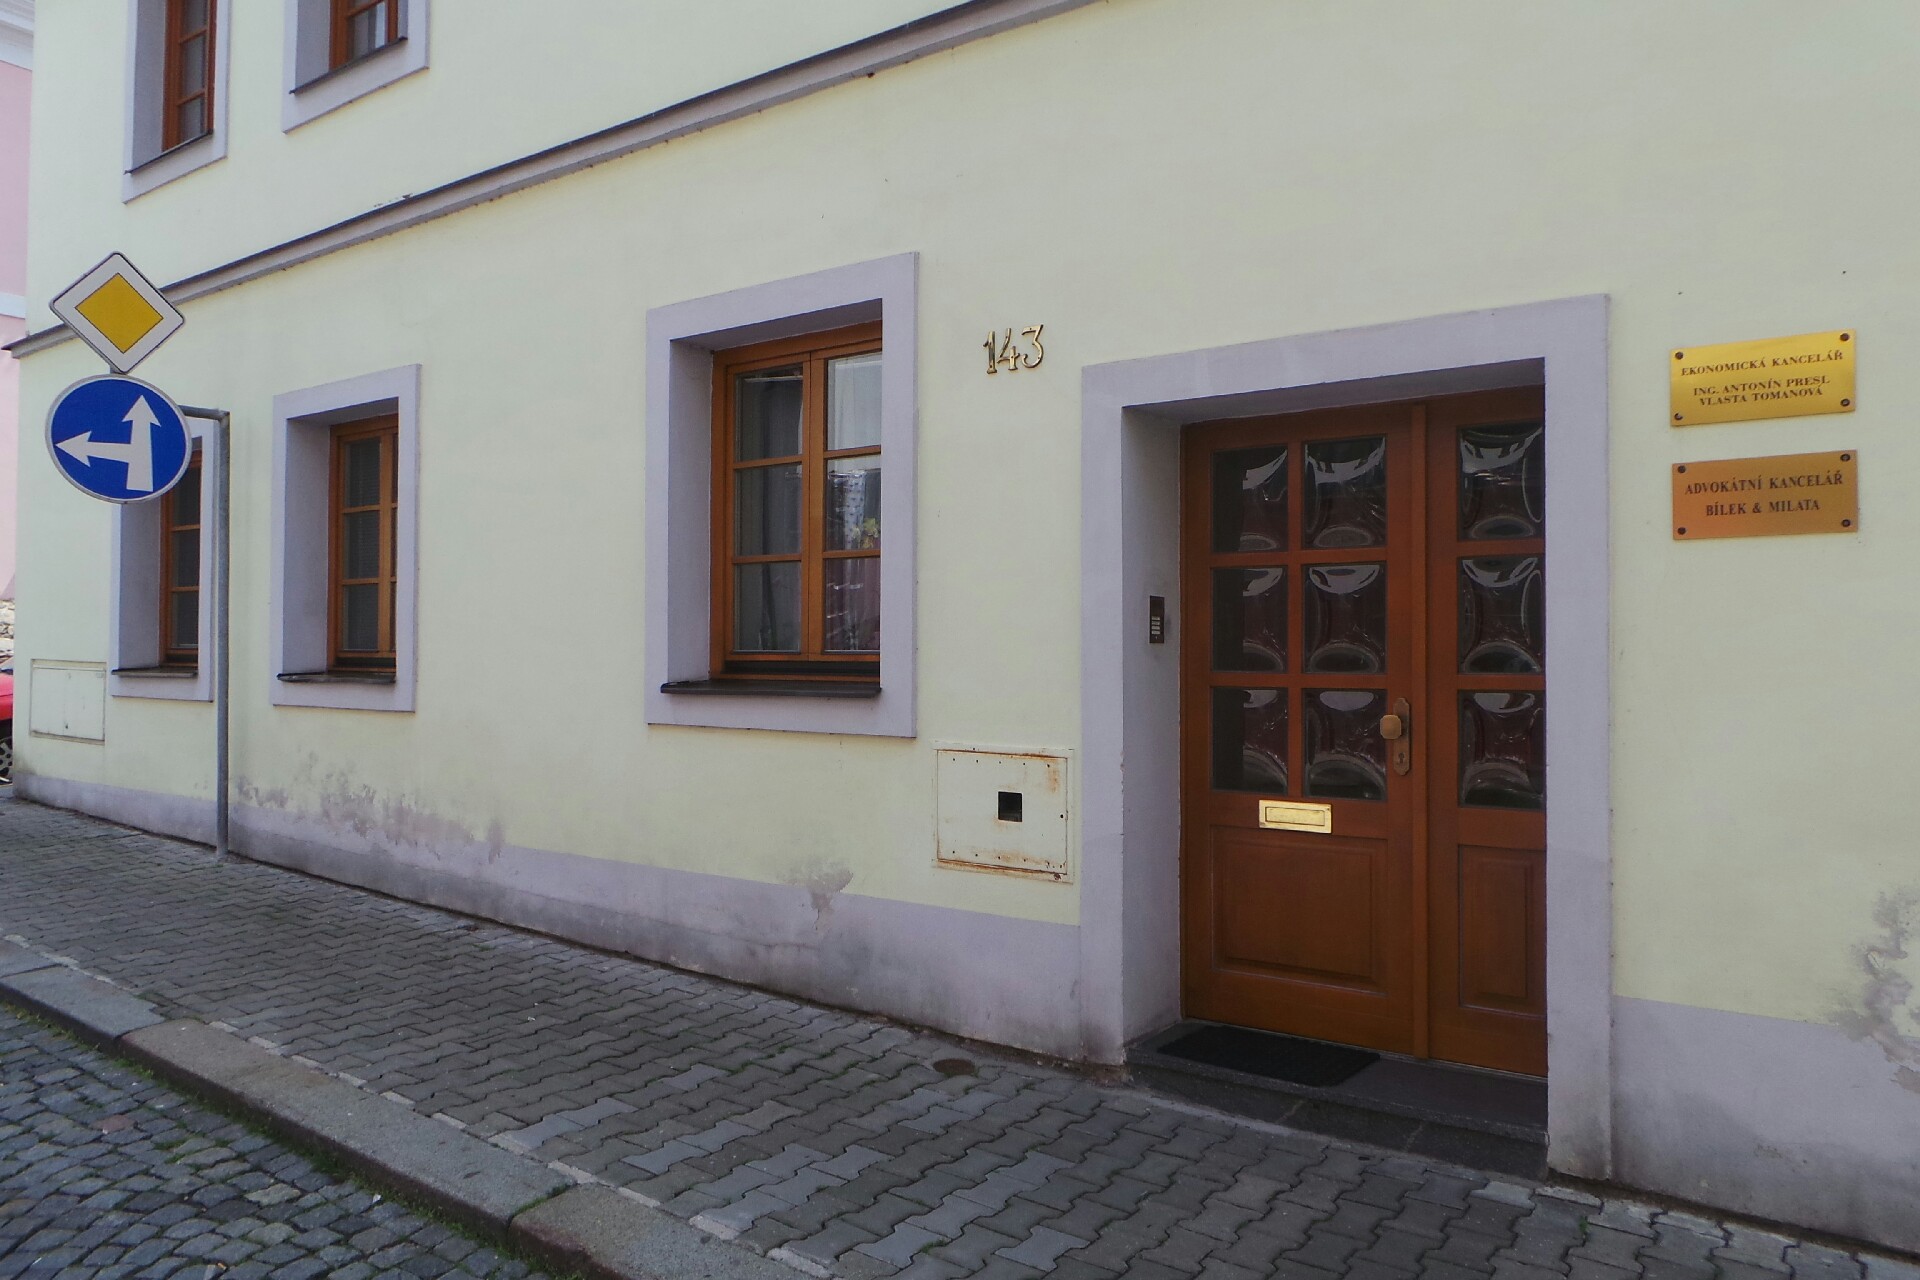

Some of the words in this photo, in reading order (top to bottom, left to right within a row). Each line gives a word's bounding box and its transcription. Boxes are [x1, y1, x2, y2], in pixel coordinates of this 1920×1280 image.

[983, 324, 1044, 374] 143
[1681, 357, 1766, 376] EKONOMICKÁ
[1772, 350, 1843, 367] KANCELÁŘ
[1693, 387, 1719, 396] ING.
[1722, 378, 1783, 394] ANTONÍN
[1786, 375, 1830, 388] PRESL
[1700, 394, 1747, 406] VLASTA
[1752, 386, 1823, 402] TOMANOVÁ
[1685, 475, 1762, 495] ADVOKÁTNÍ
[1769, 470, 1843, 489] KANCELÁŘ
[1706, 501, 1746, 516] BÍLEK
[1752, 502, 1763, 514] &
[1769, 499, 1820, 513] MILATA
